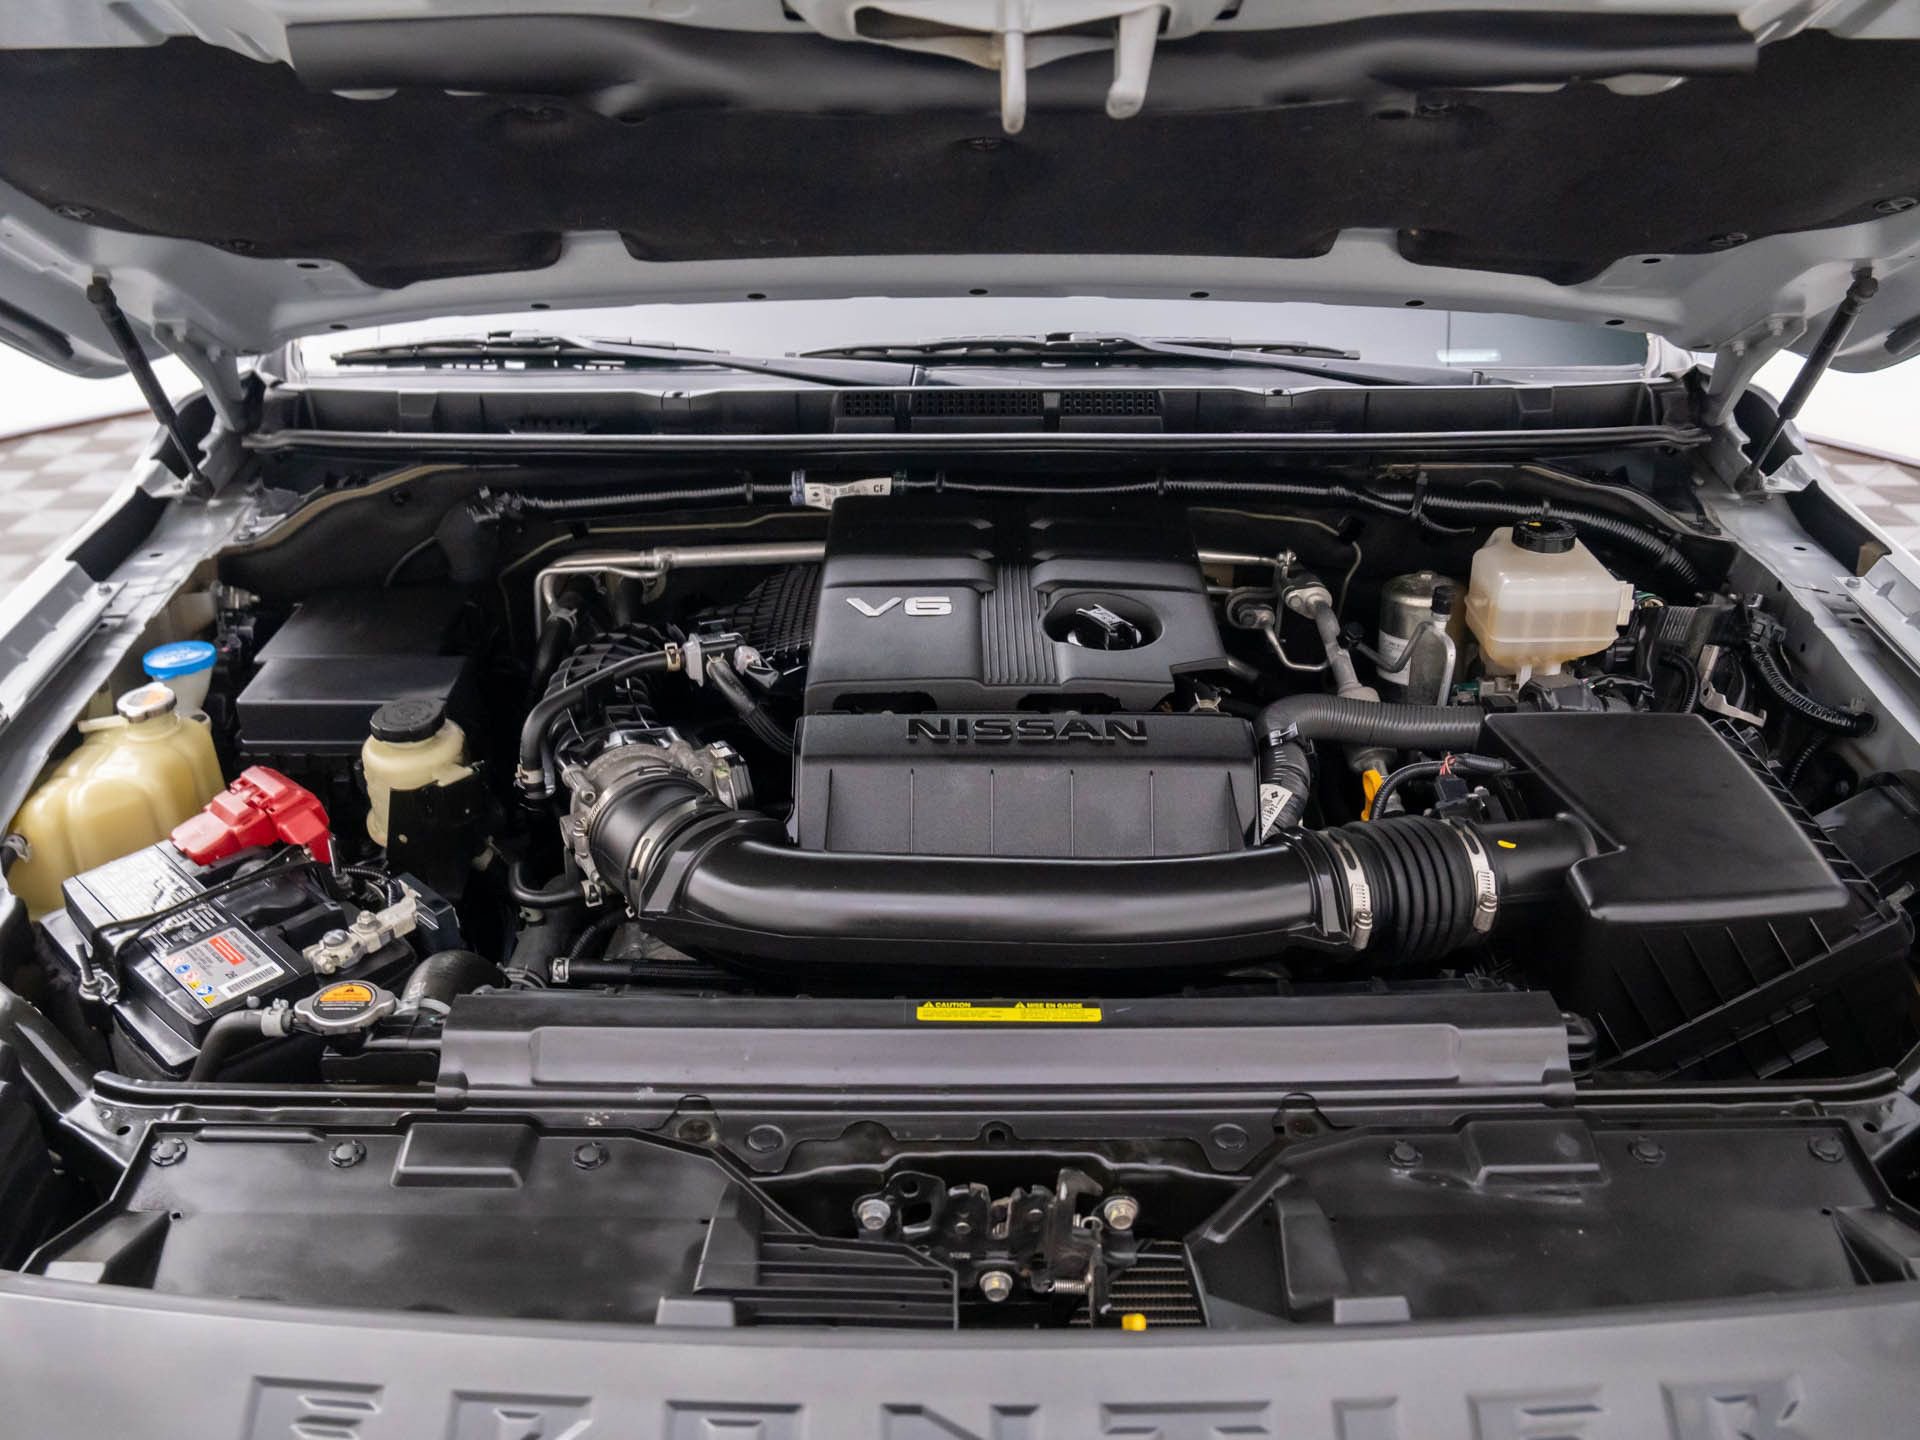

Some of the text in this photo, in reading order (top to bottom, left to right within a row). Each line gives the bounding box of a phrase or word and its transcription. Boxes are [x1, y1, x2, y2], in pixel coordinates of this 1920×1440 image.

[873, 484, 885, 493] CF
[845, 596, 952, 617] V6
[905, 718, 1148, 743] NISSAN
